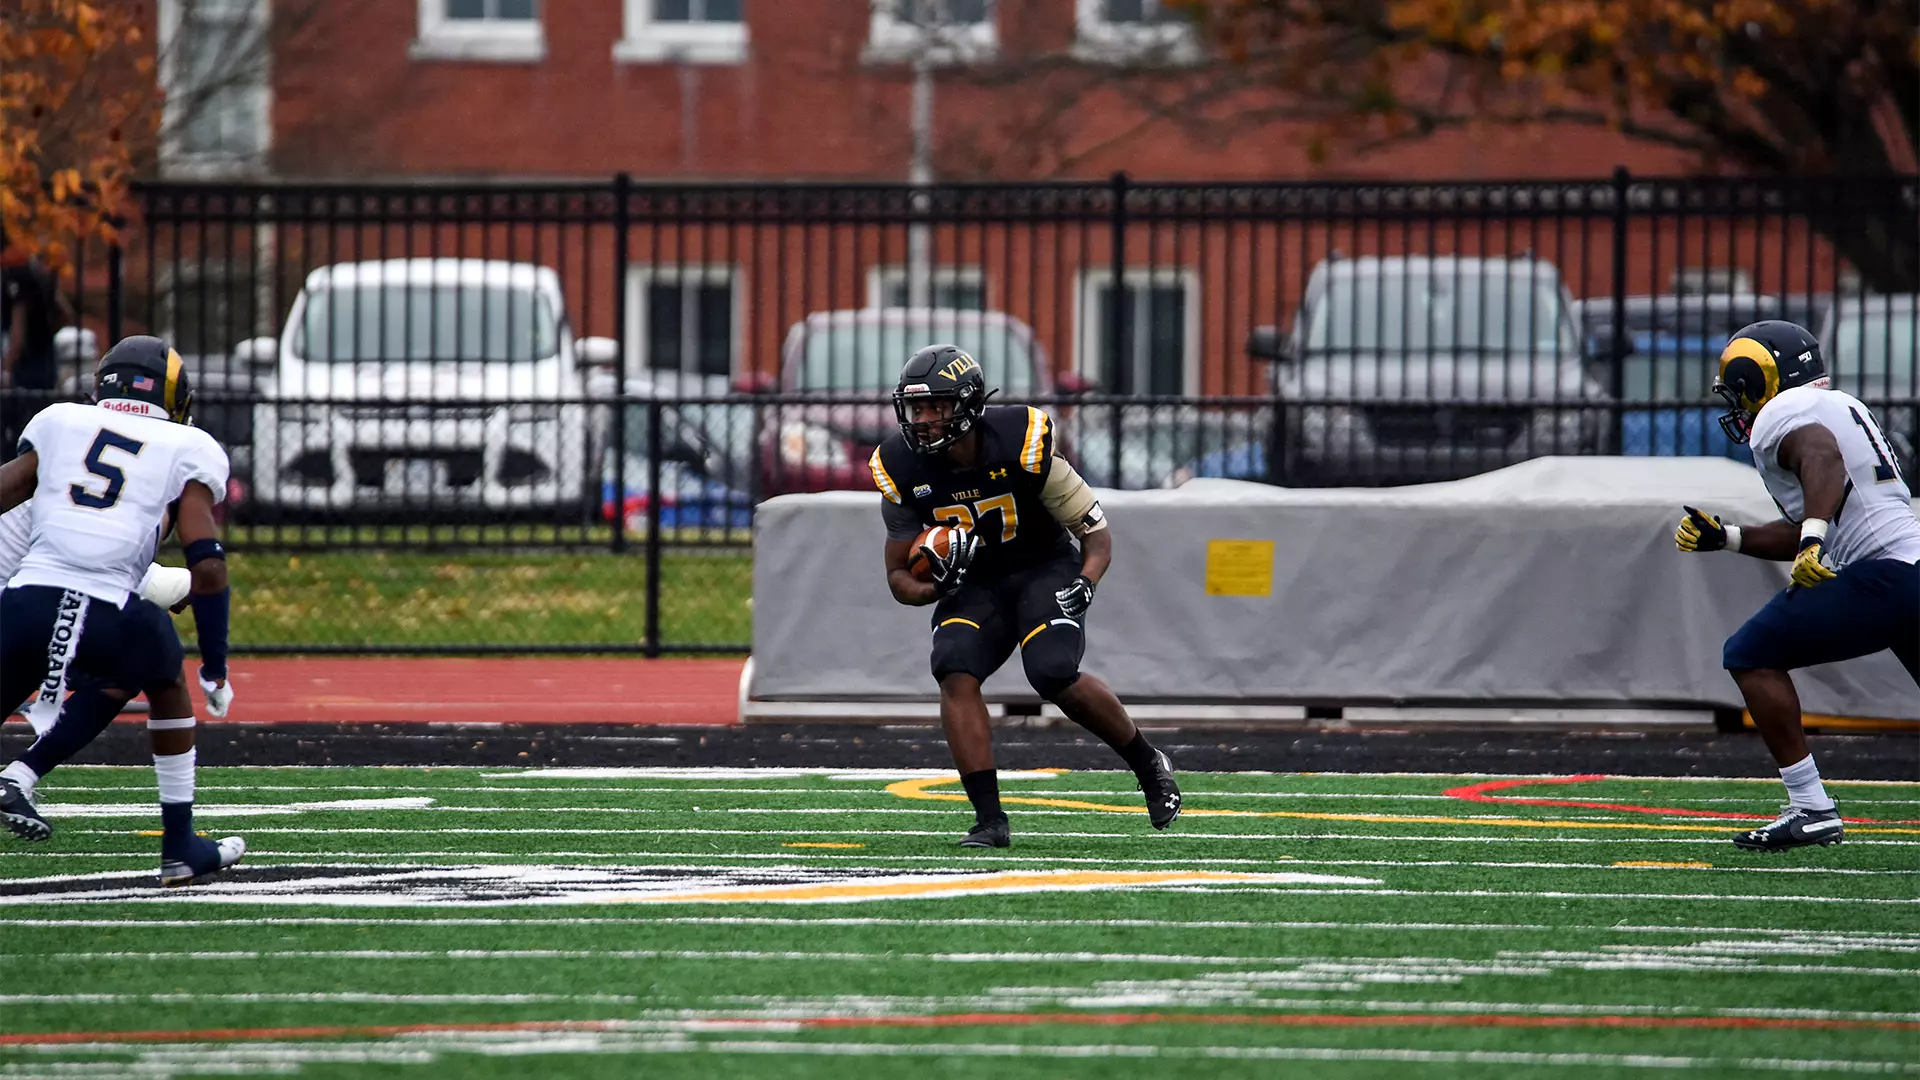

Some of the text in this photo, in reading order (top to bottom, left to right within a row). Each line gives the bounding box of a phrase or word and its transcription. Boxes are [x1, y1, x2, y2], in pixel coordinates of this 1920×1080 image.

[103, 401, 149, 414] Riddell
[69, 427, 146, 511] 5
[951, 488, 981, 501] VILLE
[40, 588, 84, 704] ATORADE
